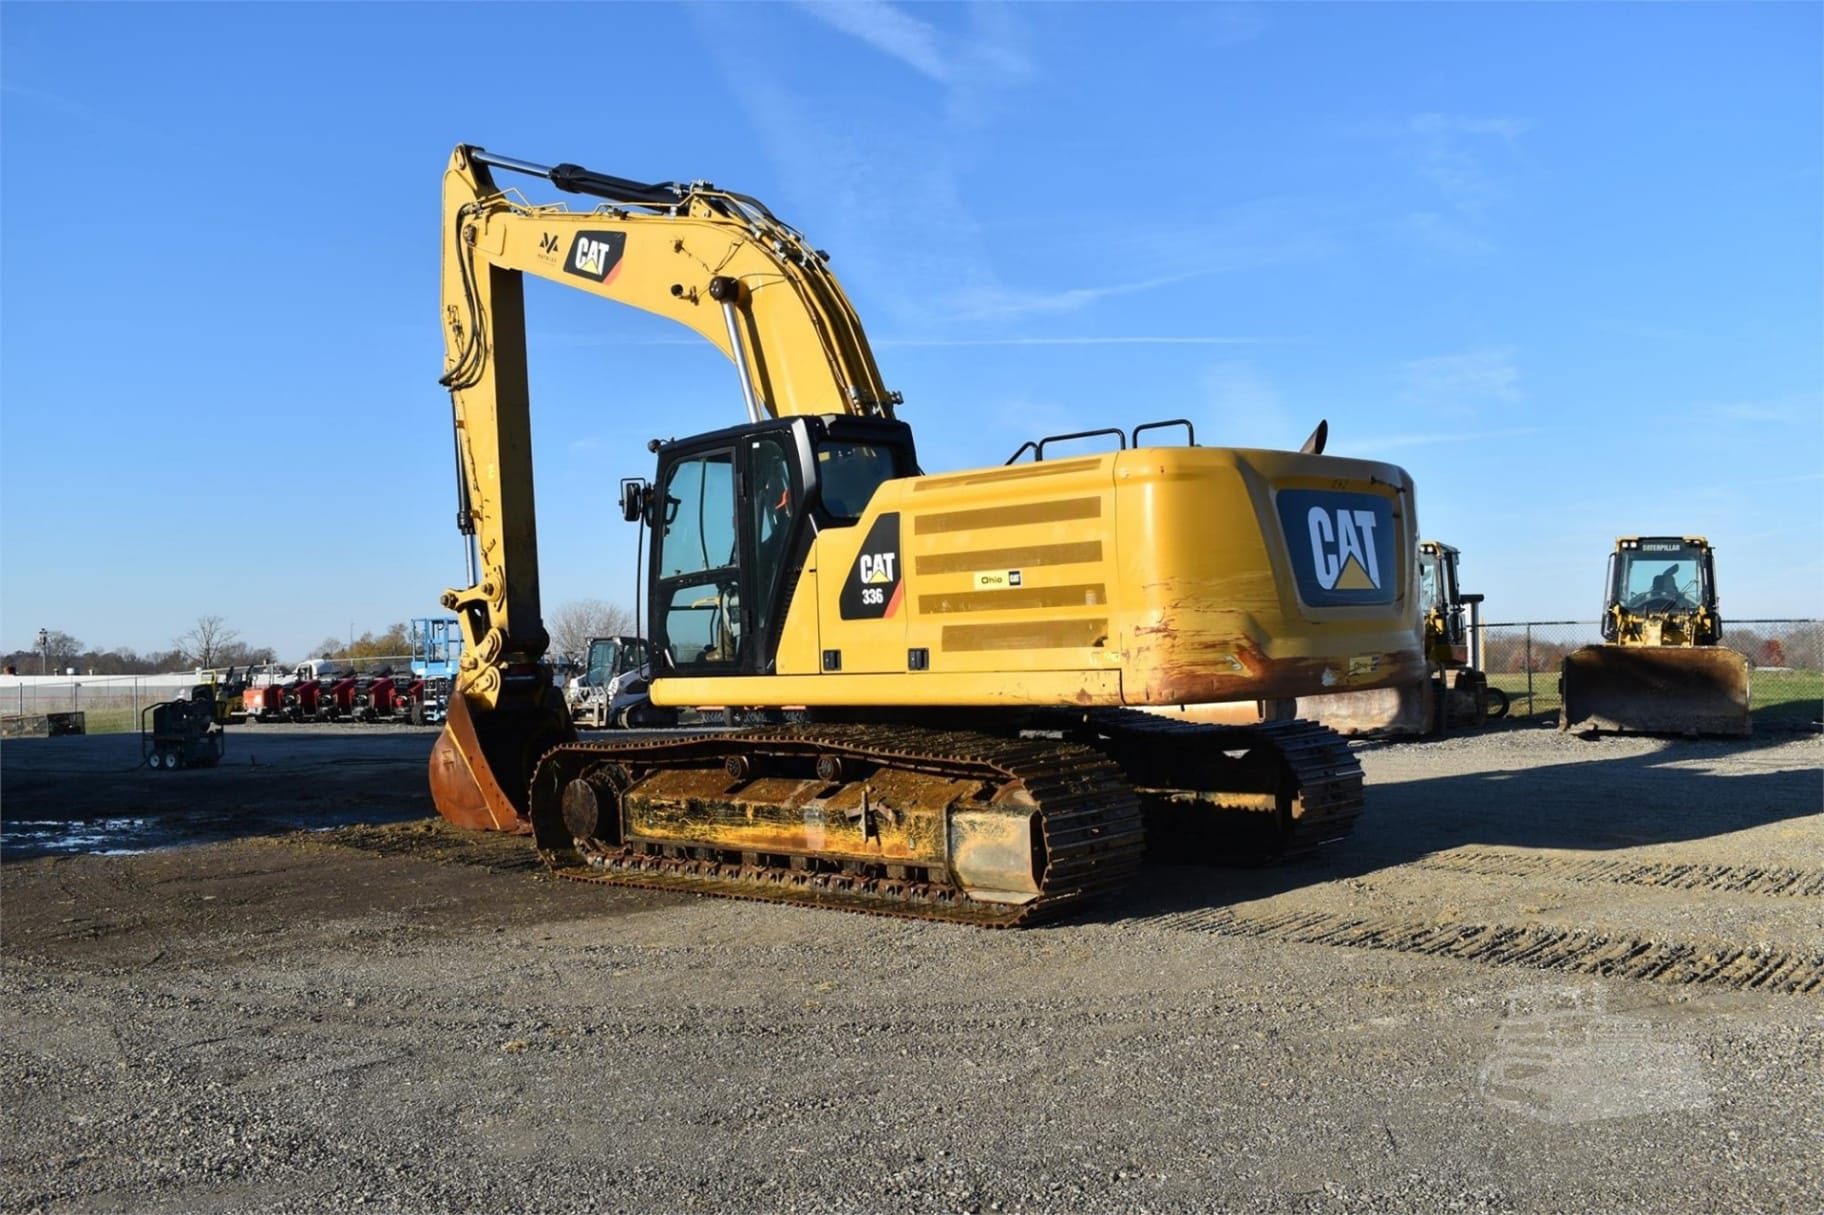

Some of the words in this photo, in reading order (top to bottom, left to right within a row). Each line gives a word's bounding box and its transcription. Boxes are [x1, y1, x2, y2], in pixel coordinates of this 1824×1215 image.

[576, 237, 610, 275] CAT
[1308, 506, 1381, 590] CAT
[860, 552, 895, 584] CAT
[981, 576, 1003, 584] Ohio
[862, 588, 884, 604] 336
